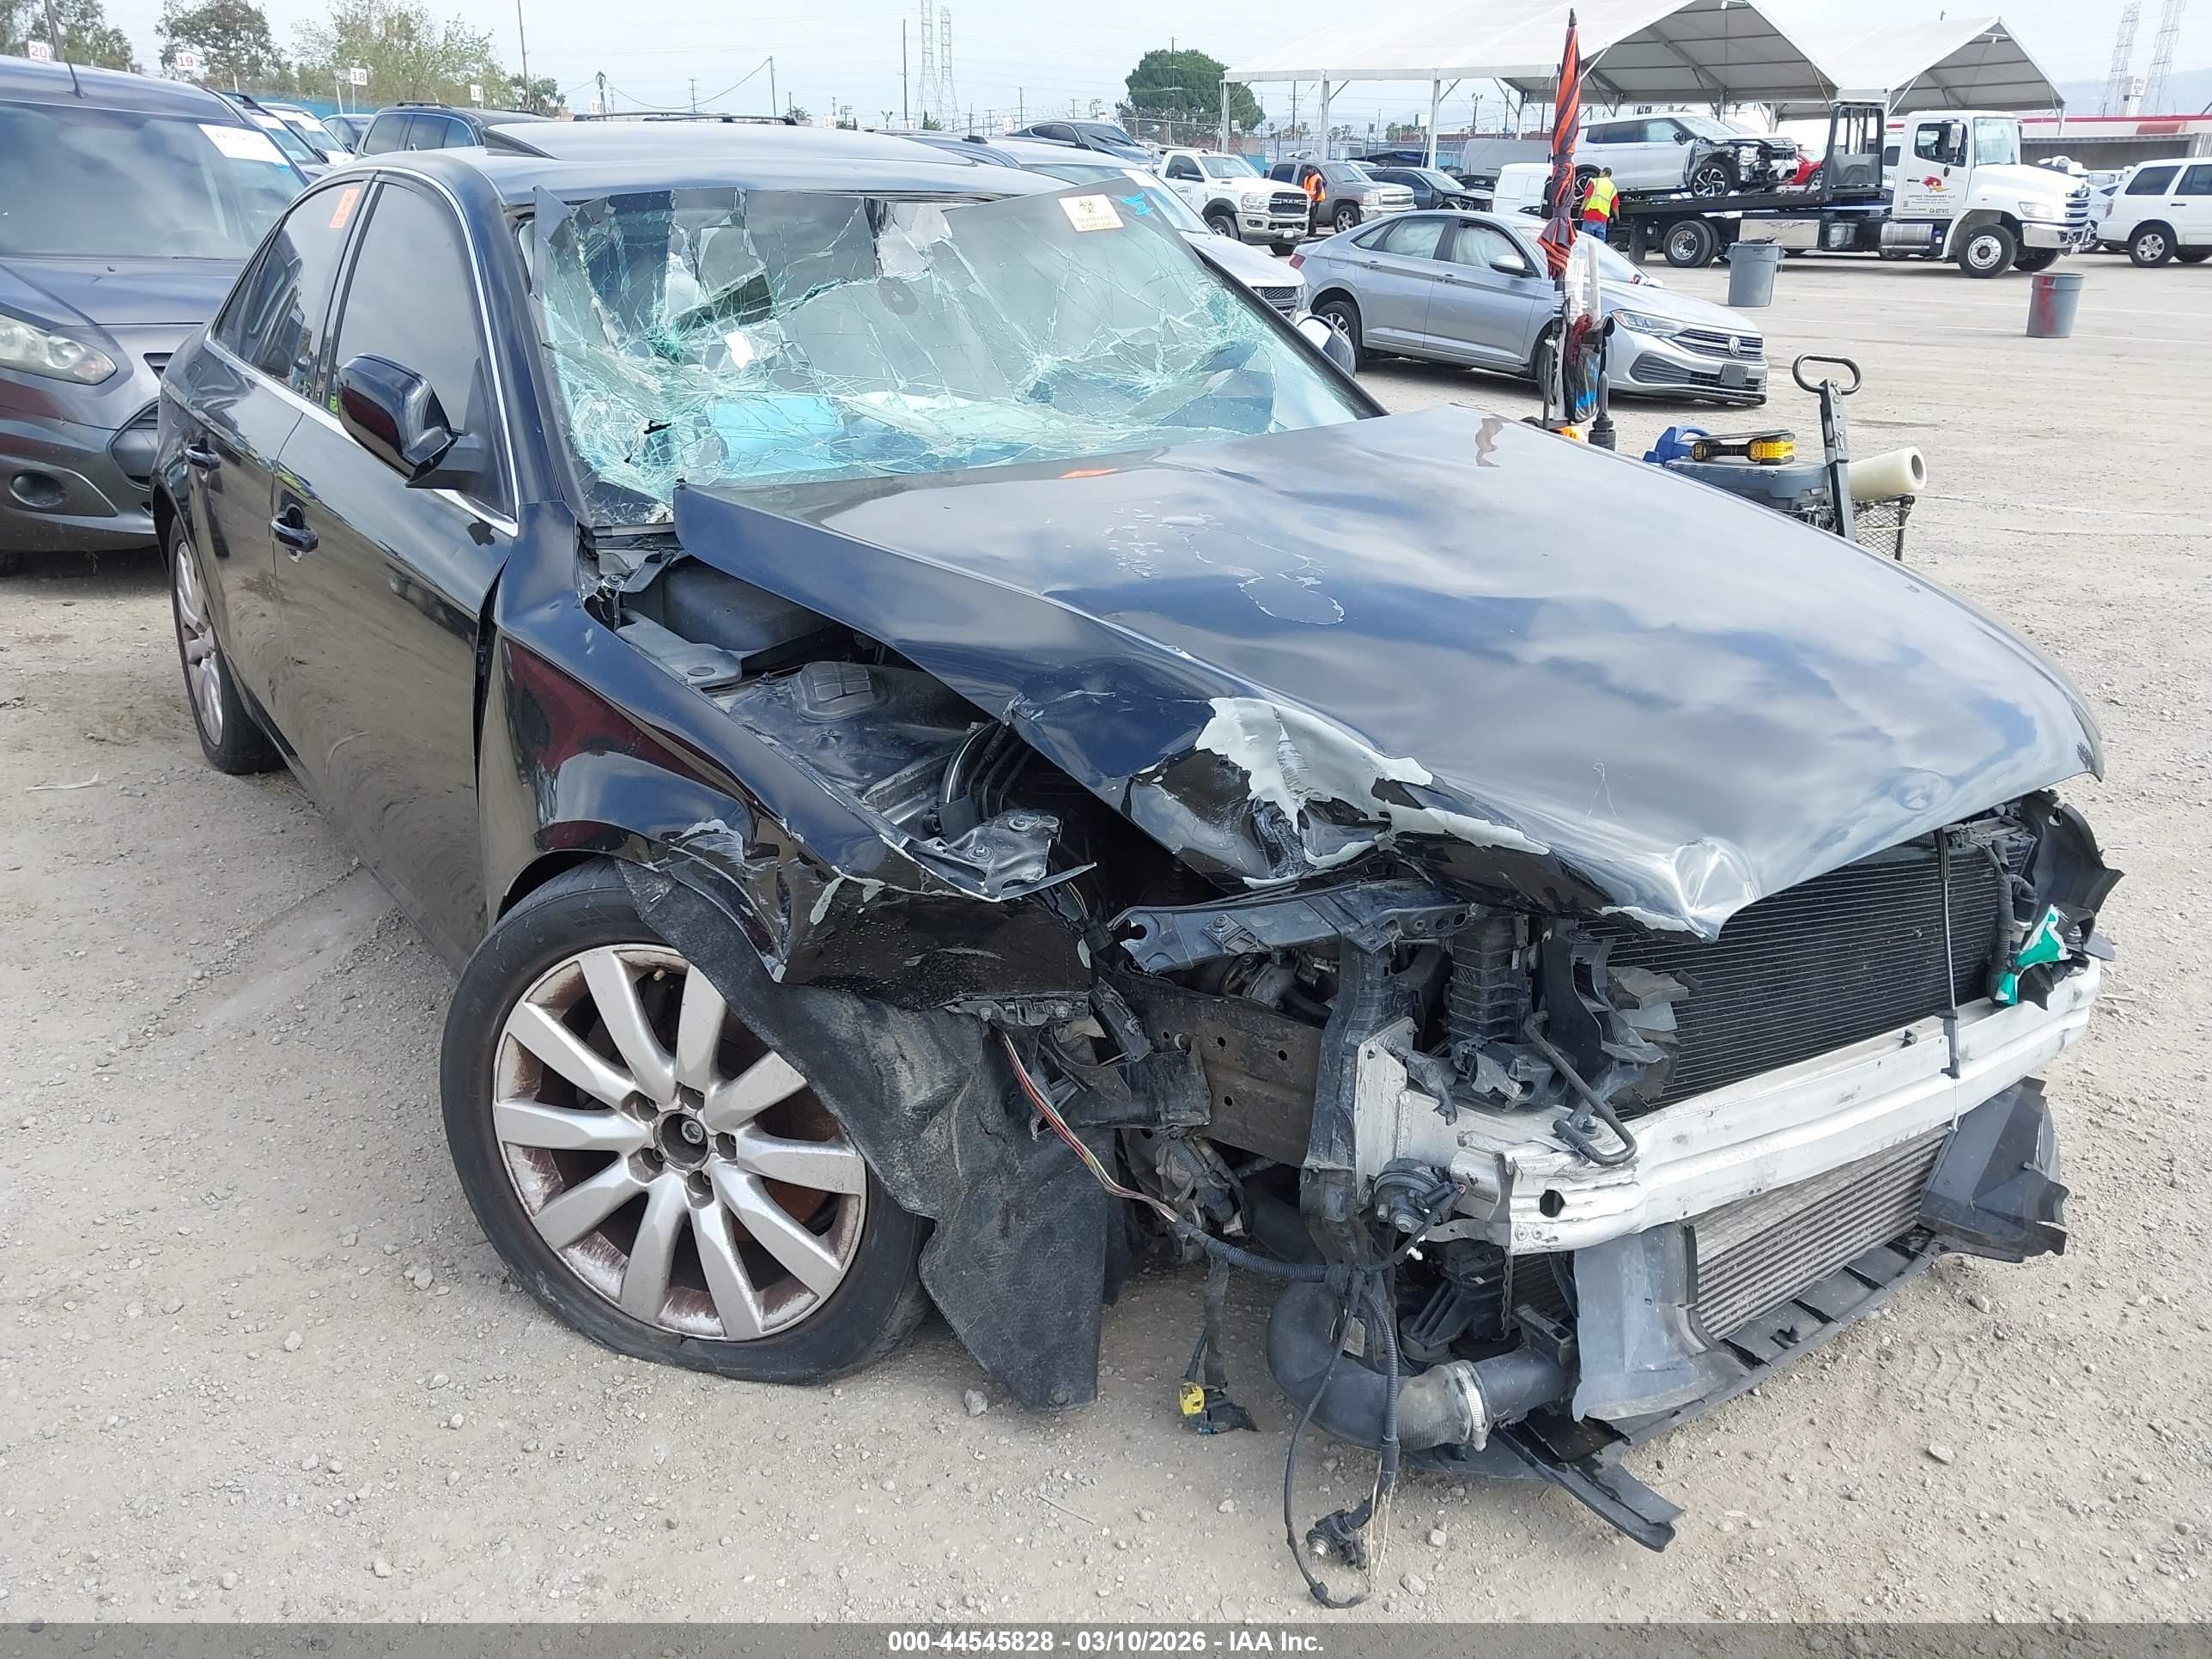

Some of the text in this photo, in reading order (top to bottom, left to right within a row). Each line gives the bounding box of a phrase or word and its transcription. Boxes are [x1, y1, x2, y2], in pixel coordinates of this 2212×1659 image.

[30, 45, 47, 58] 20
[178, 56, 193, 67] 19
[352, 71, 366, 82] 18
[825, 118, 835, 127] 14
